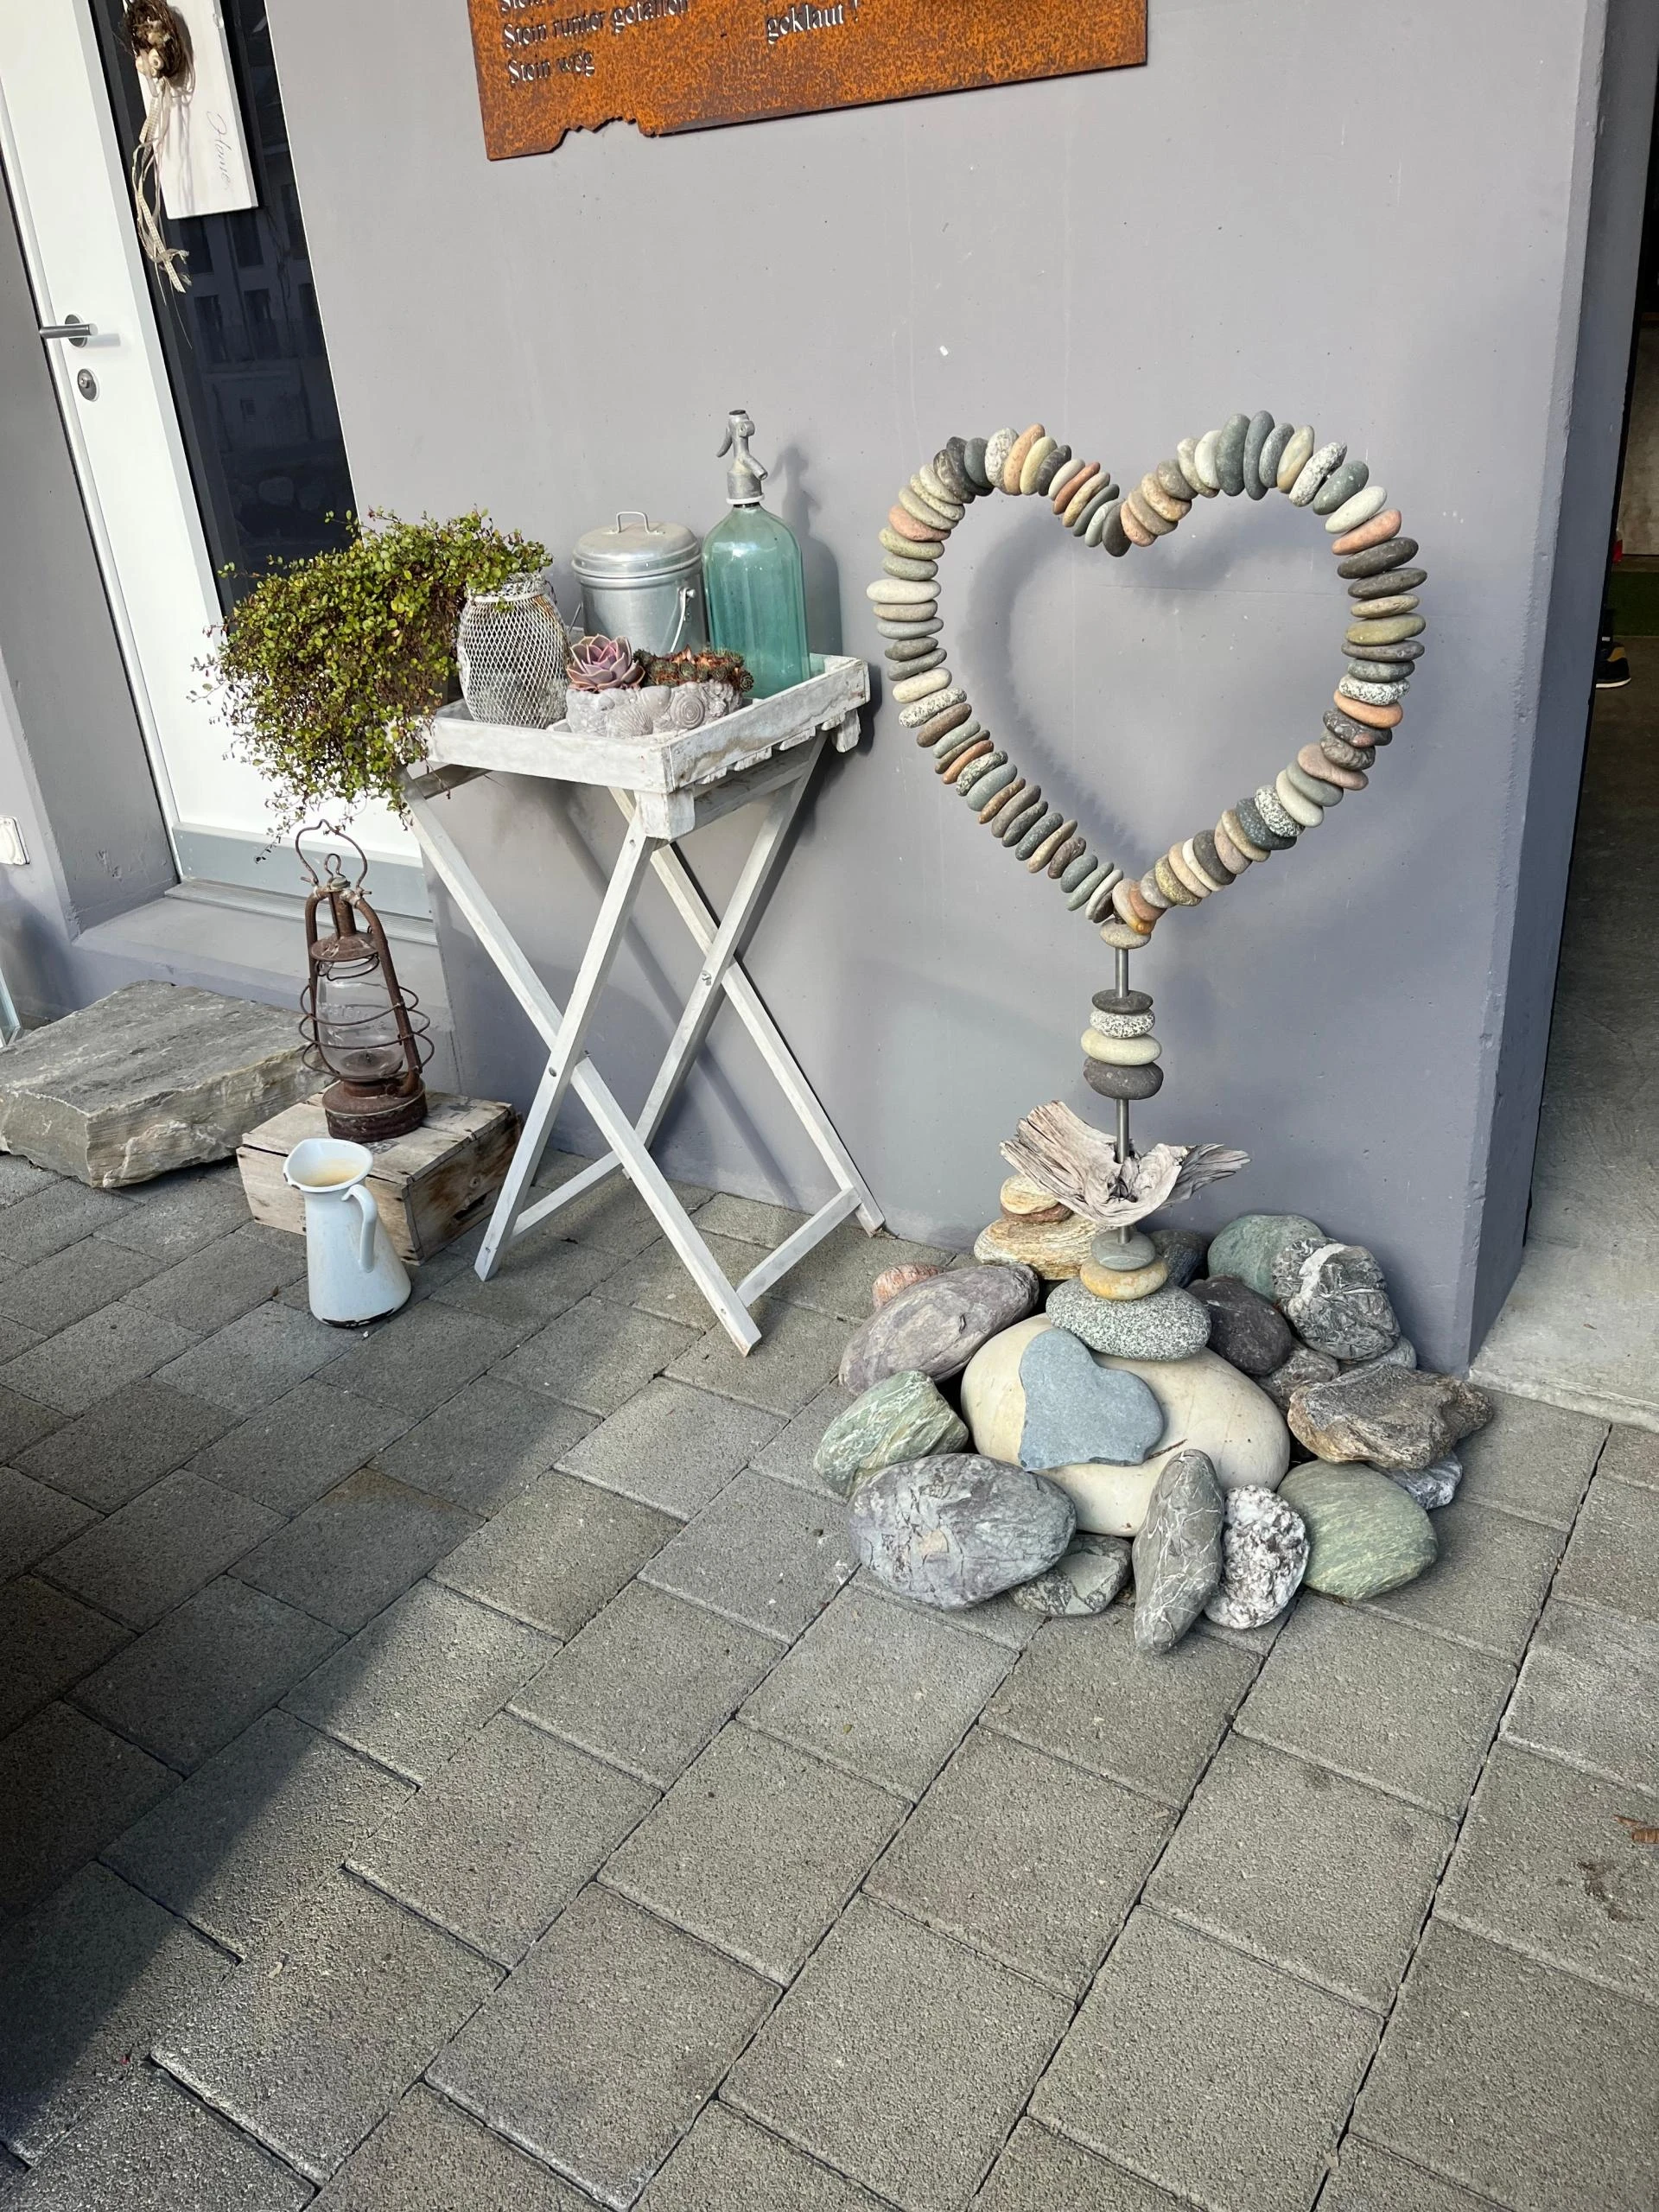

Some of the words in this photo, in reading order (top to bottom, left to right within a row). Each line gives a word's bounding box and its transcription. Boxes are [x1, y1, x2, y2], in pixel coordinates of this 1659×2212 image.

[503, 22, 547, 48] Stein
[552, 10, 605, 38] runter
[613, 0, 689, 35] gefallen
[766, 3, 844, 46] geklaut
[508, 59, 550, 85] Stein
[556, 49, 595, 78] weg
